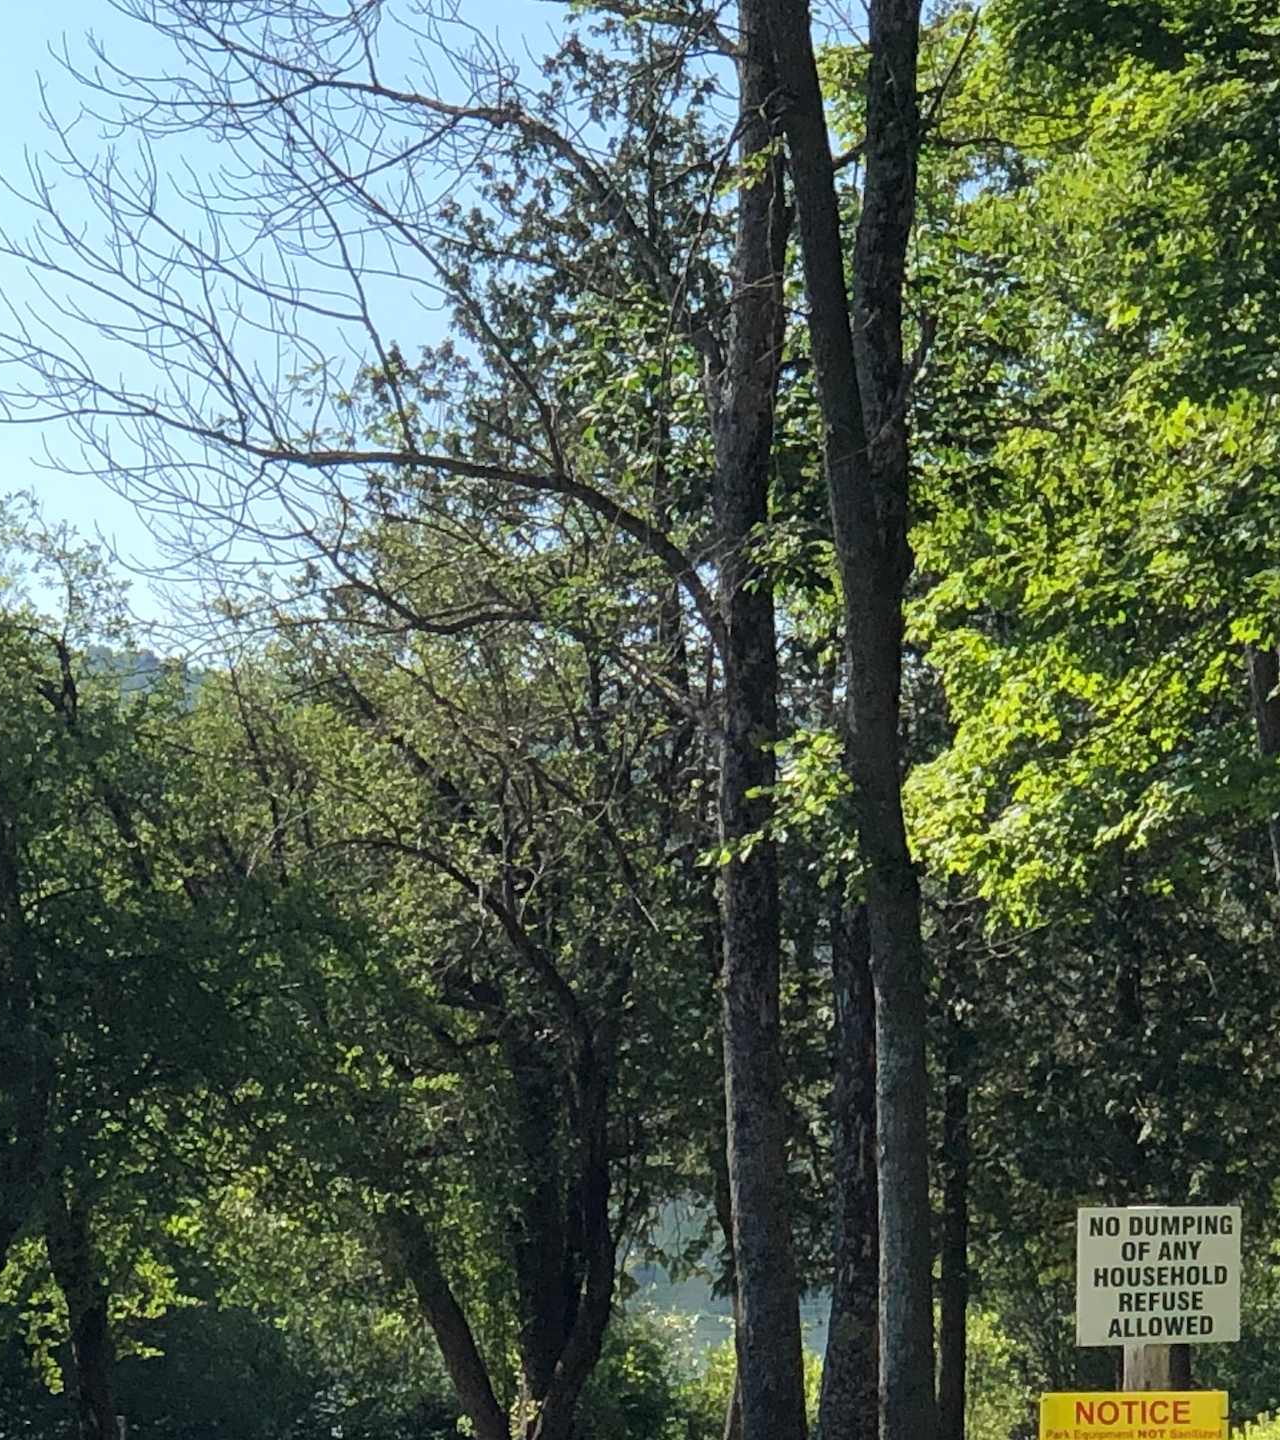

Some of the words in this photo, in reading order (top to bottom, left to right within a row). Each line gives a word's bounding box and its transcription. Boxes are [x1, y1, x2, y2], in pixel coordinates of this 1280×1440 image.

[1089, 1216, 1120, 1237] NO
[1129, 1215, 1233, 1236] DUMPING
[1121, 1241, 1151, 1261] OF
[1158, 1241, 1202, 1261] ANY
[1094, 1265, 1228, 1287] HOUSEHOLD
[1118, 1291, 1203, 1312] REFUSE
[1108, 1316, 1213, 1338] ALLOWED
[1075, 1400, 1191, 1425] NOTICE
[1045, 1429, 1070, 1440] Park
[1137, 1429, 1165, 1440] NOT
